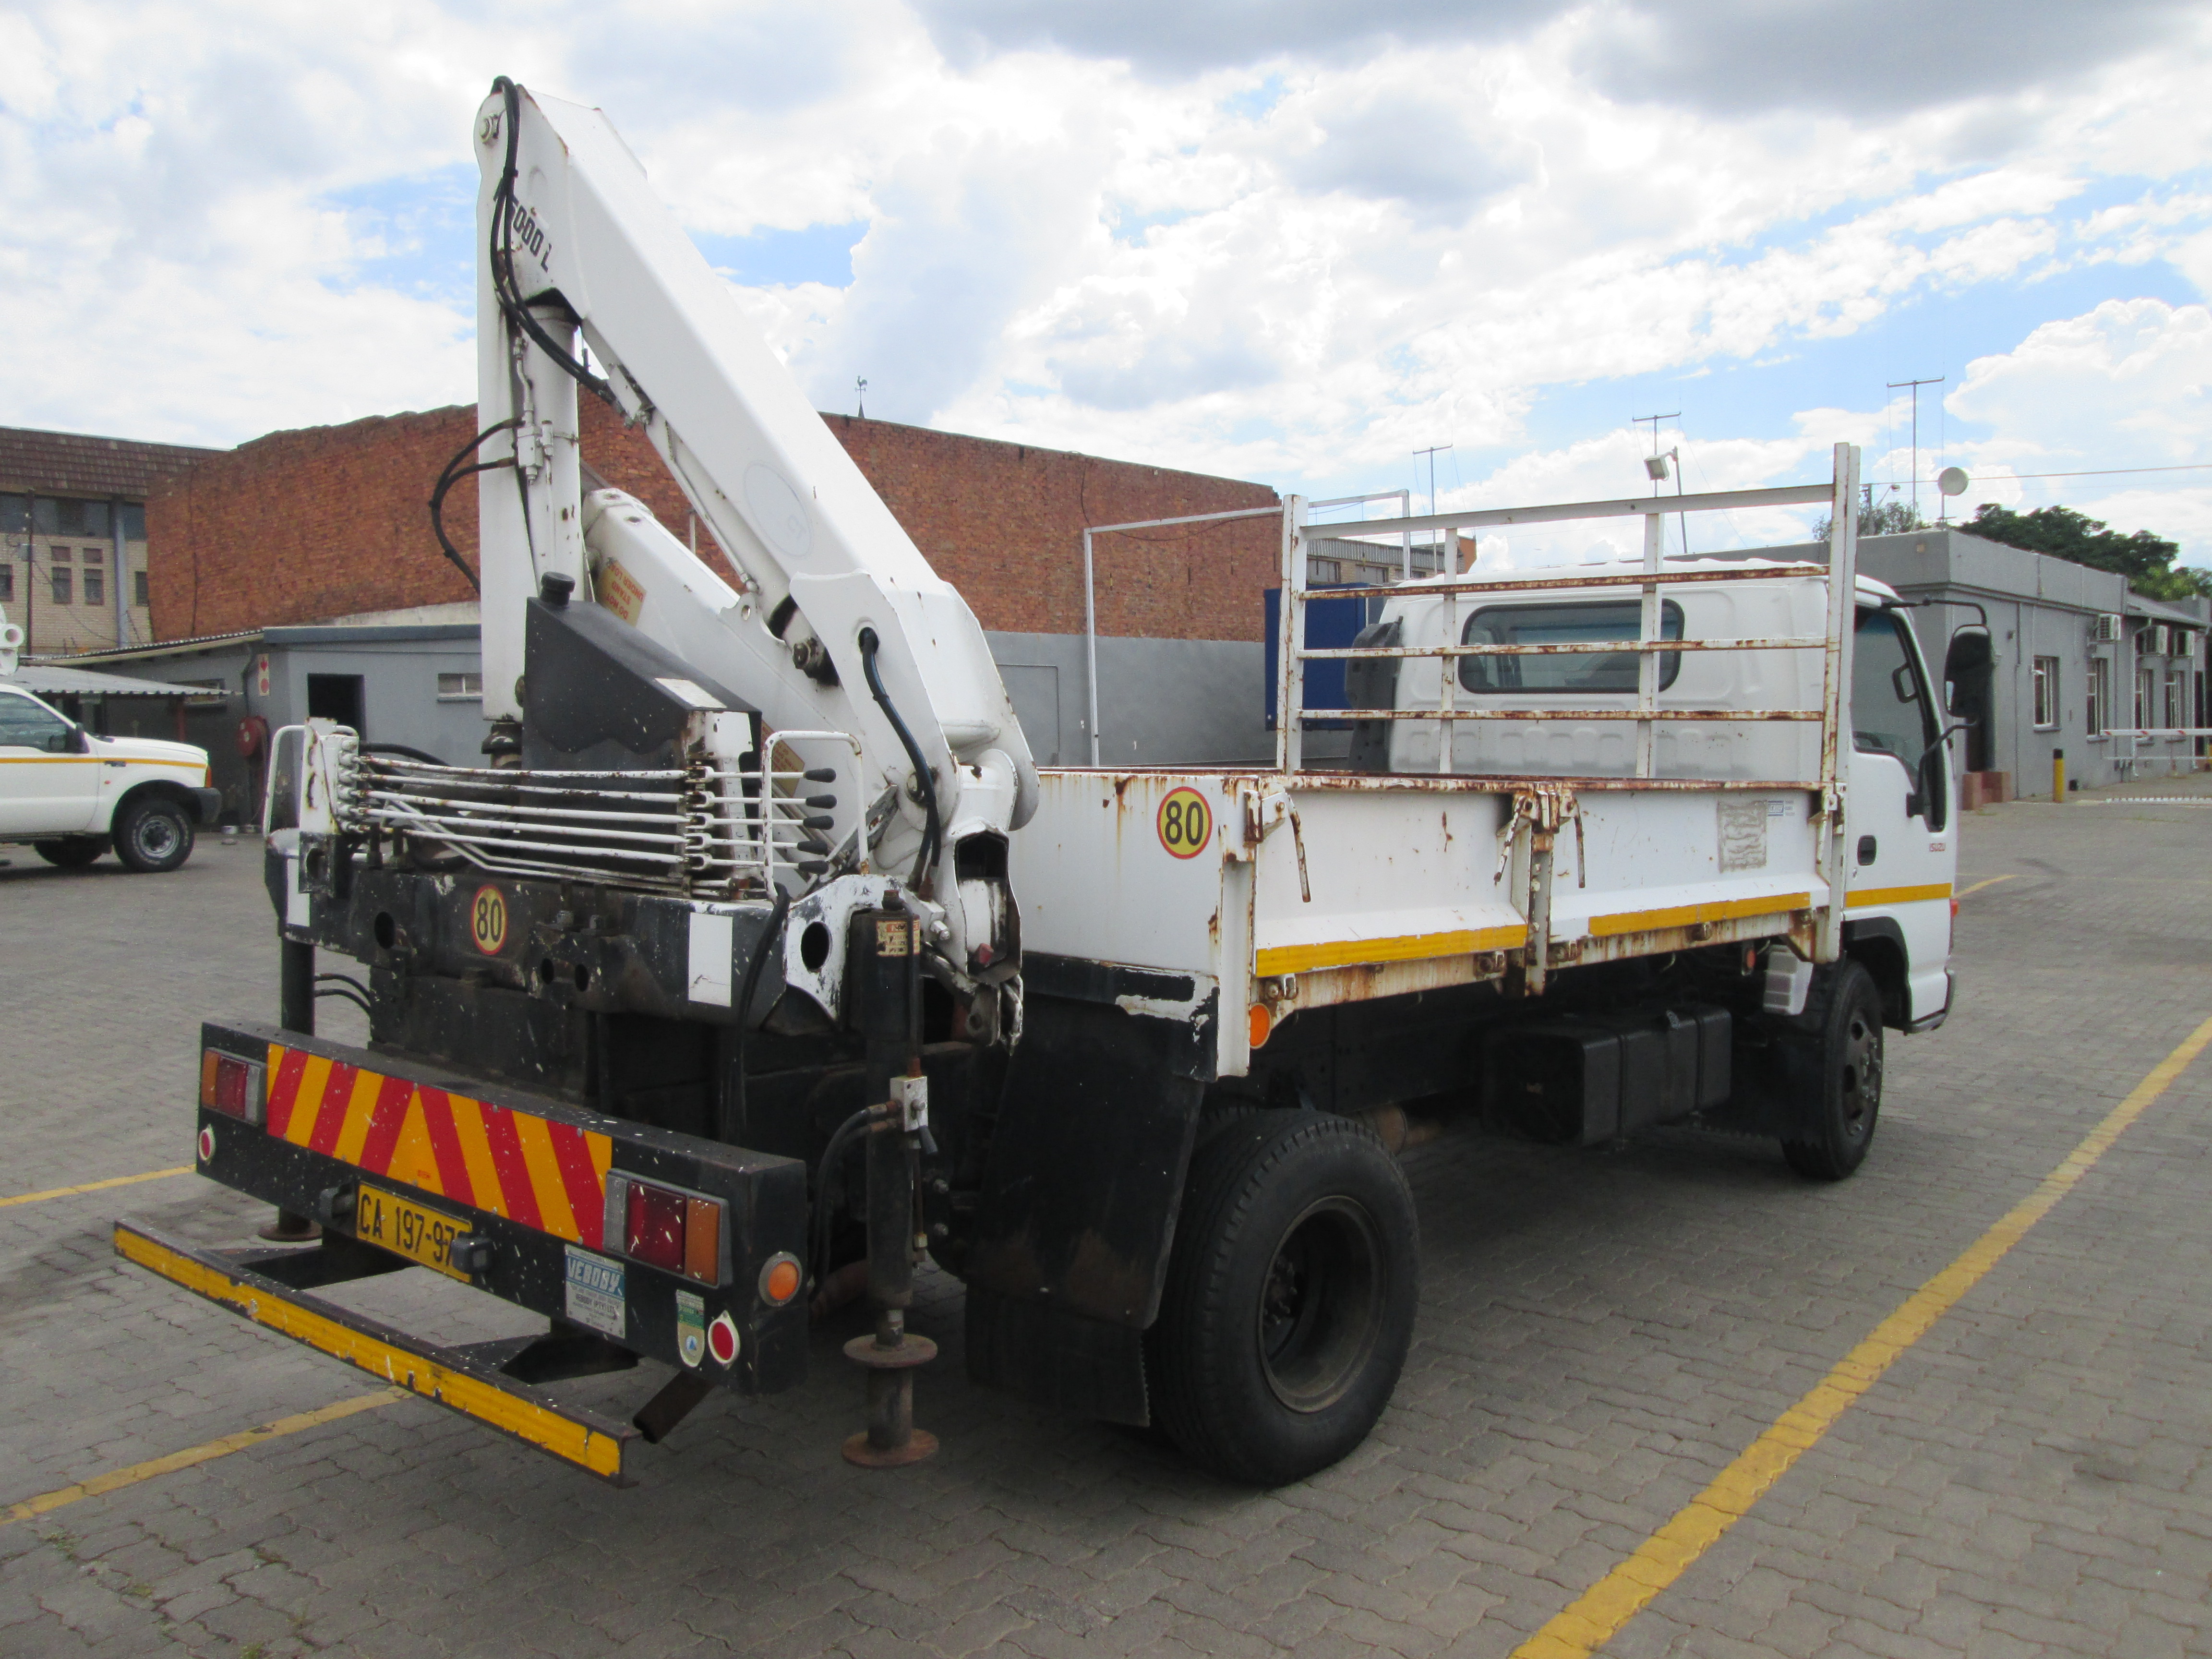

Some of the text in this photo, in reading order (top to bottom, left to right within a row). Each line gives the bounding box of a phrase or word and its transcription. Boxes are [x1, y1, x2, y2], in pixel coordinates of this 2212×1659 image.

[541, 243, 552, 274] L
[612, 581, 631, 605] STAND
[623, 576, 644, 602] UNDER
[619, 606, 629, 619] DO
[1165, 800, 1203, 846] 80
[1930, 842, 1946, 852] ISUZU
[477, 897, 502, 942] 80
[361, 1194, 469, 1266] CA 197-97
